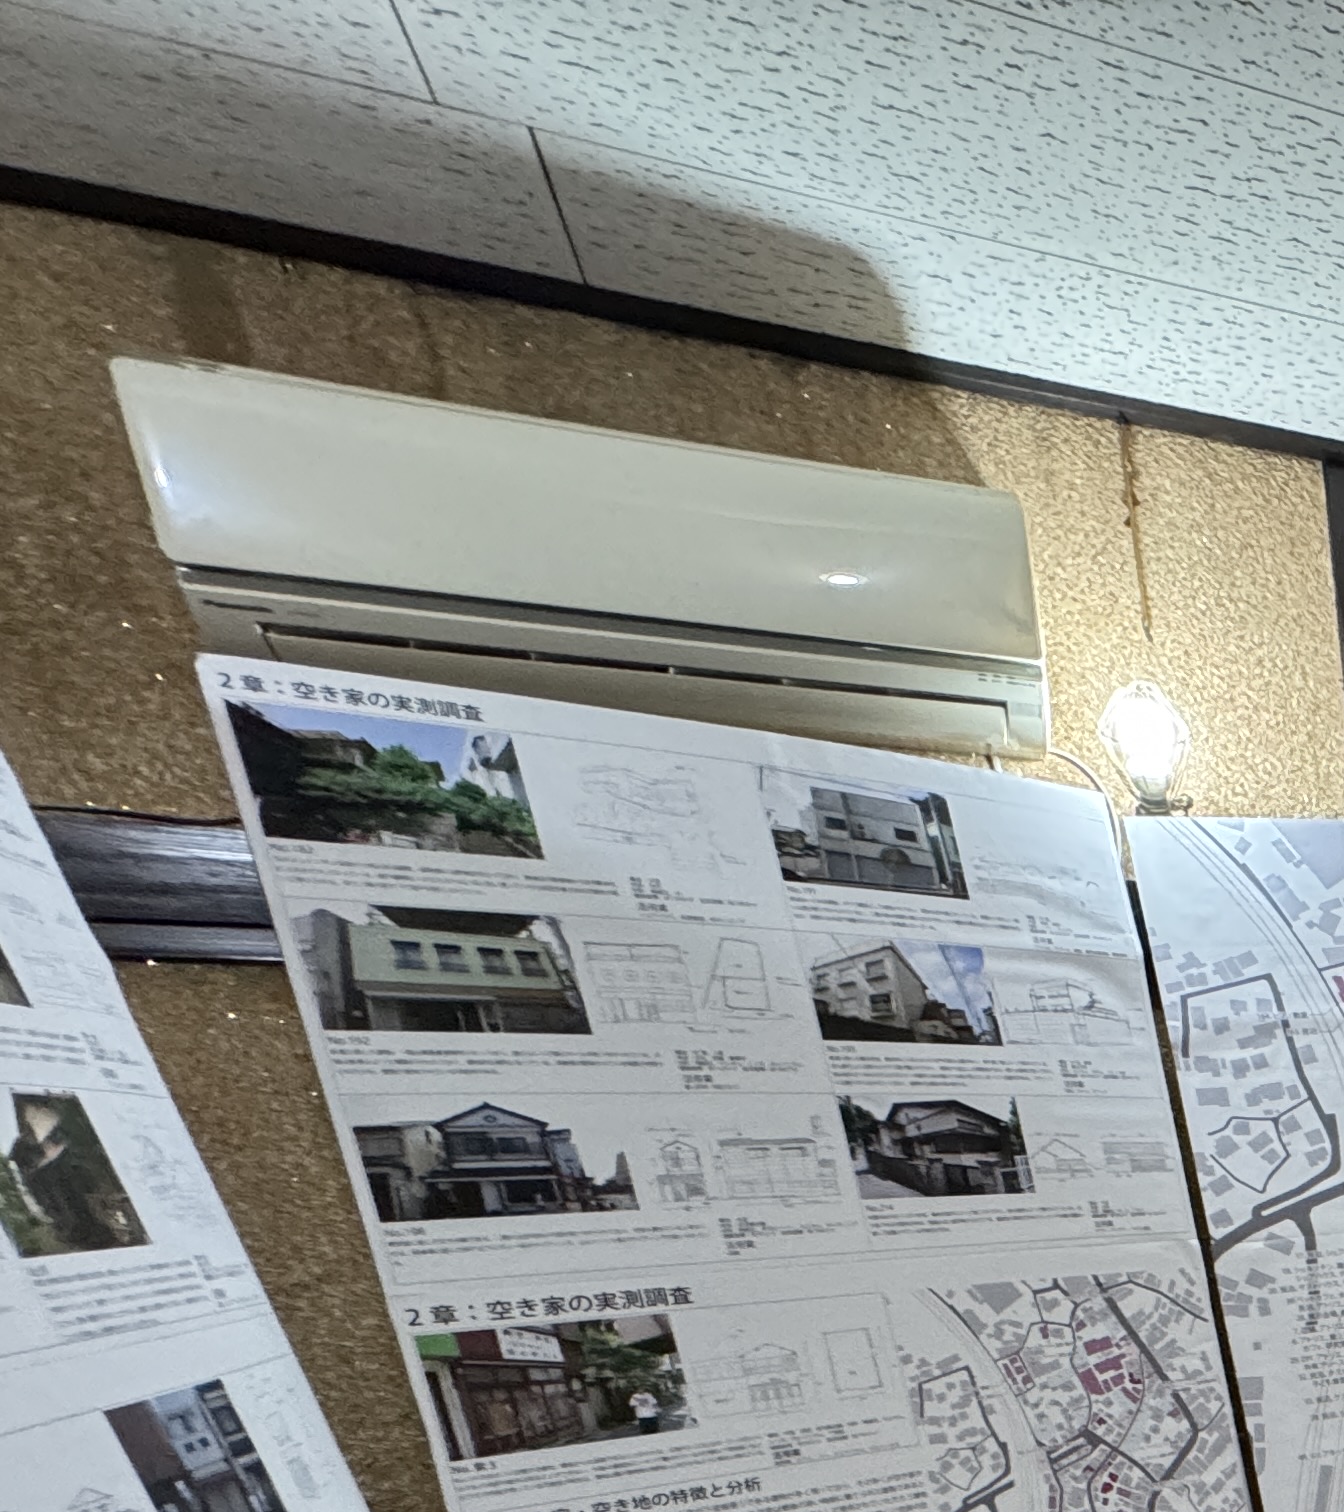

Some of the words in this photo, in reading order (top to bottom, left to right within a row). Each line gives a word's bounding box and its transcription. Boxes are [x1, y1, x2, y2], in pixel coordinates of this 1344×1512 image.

[404, 1286, 695, 1326] 2章：空き家の実測調査
